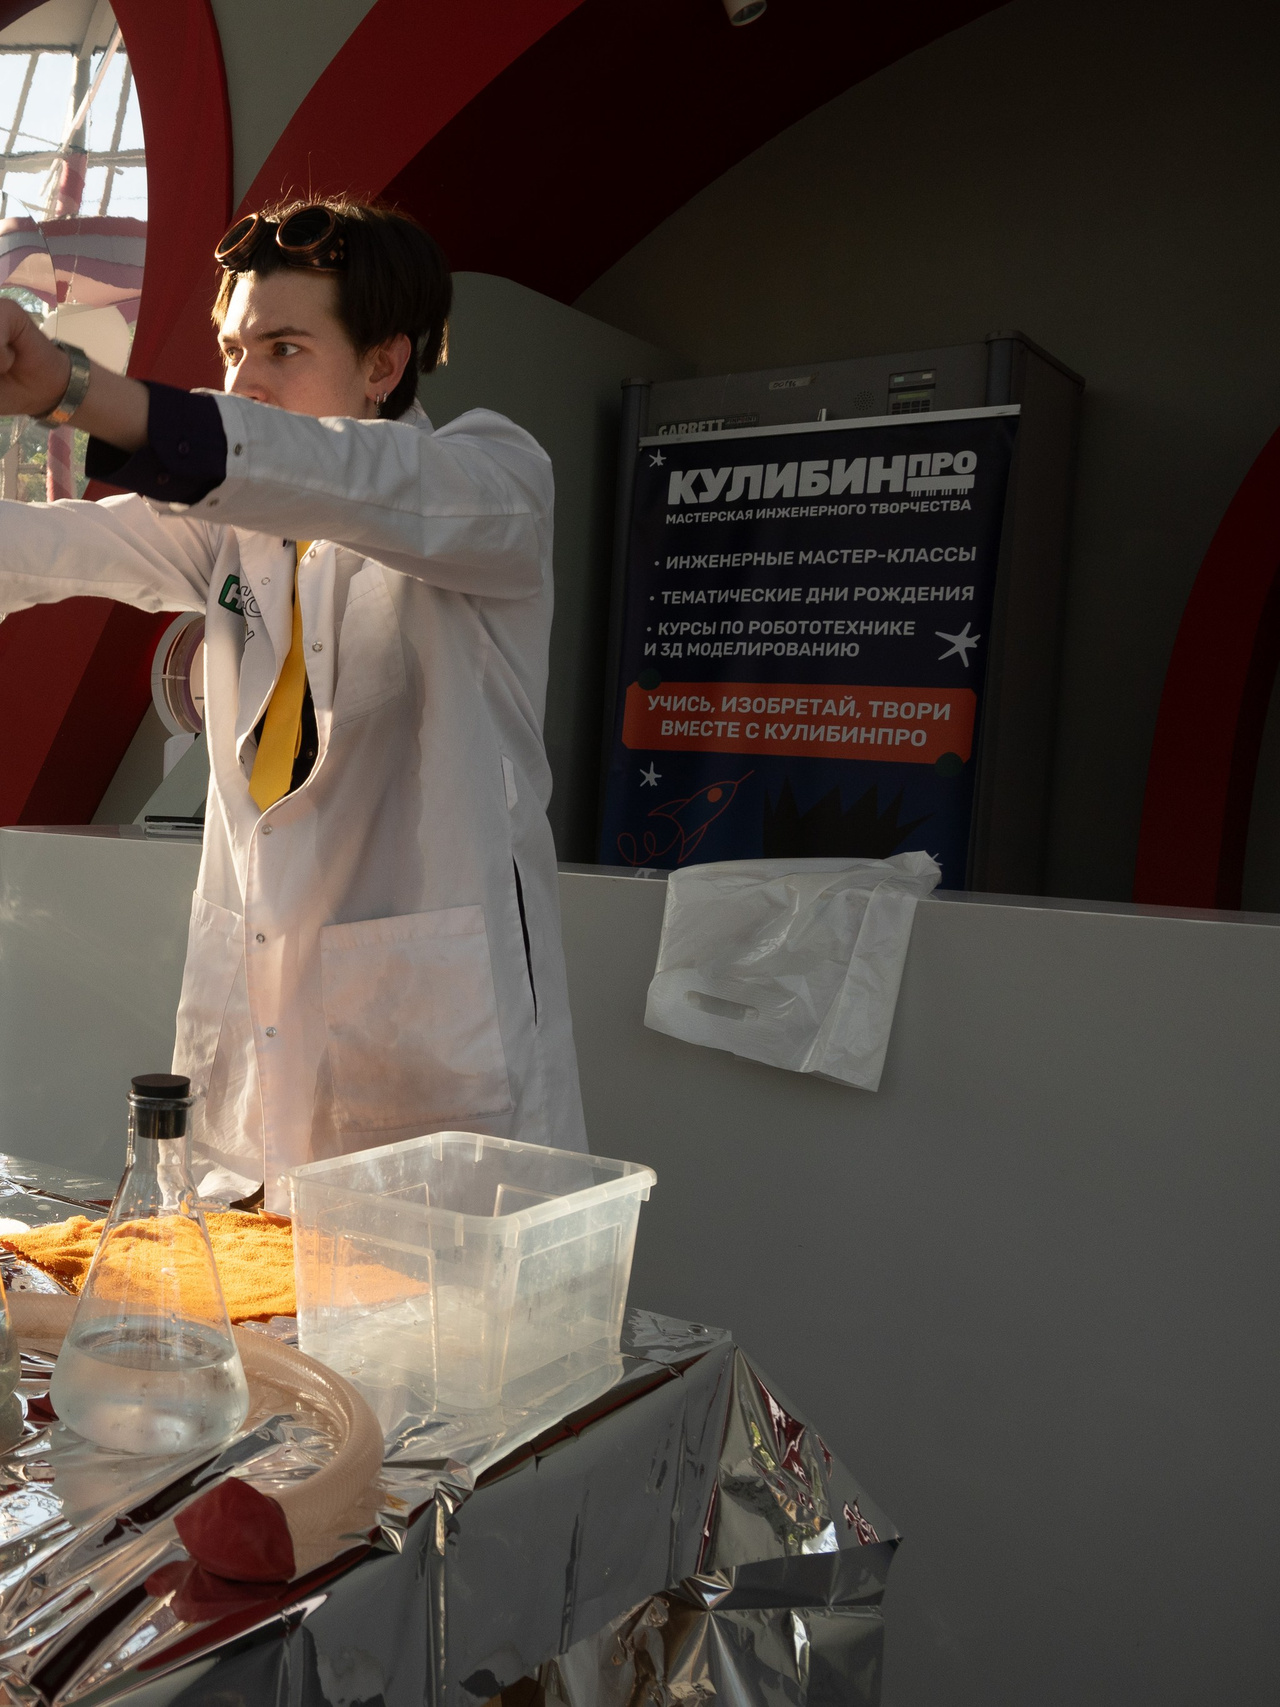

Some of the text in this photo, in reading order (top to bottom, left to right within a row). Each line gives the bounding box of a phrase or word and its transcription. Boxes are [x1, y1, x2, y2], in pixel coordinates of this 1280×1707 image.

[658, 418, 725, 436] GARRETT
[665, 499, 972, 524] МАСТЕРСКАЯ ИНЖЕНЕРНОГО ТВОРЧЕСТВА
[666, 546, 977, 569] ИНЖЕНЕРНЫЕ МАСТЕР-КЛАССЫ
[661, 585, 975, 604] ТЕМАТИЧЕСКИЕ ДНИ РОЖДЕНИЯ
[658, 620, 916, 636] КУРСЫ ПО РОБОТОТЕХНИКЕ
[644, 642, 657, 656] И
[687, 641, 860, 657] МОДЕЛИРОВАНИЮ
[647, 695, 951, 721] УЧИСЬ, ИЗОБРЕТАЙ, ТВОРИ
[661, 720, 927, 747] ВМЕСТЕ С КУЛИБИНПРО
